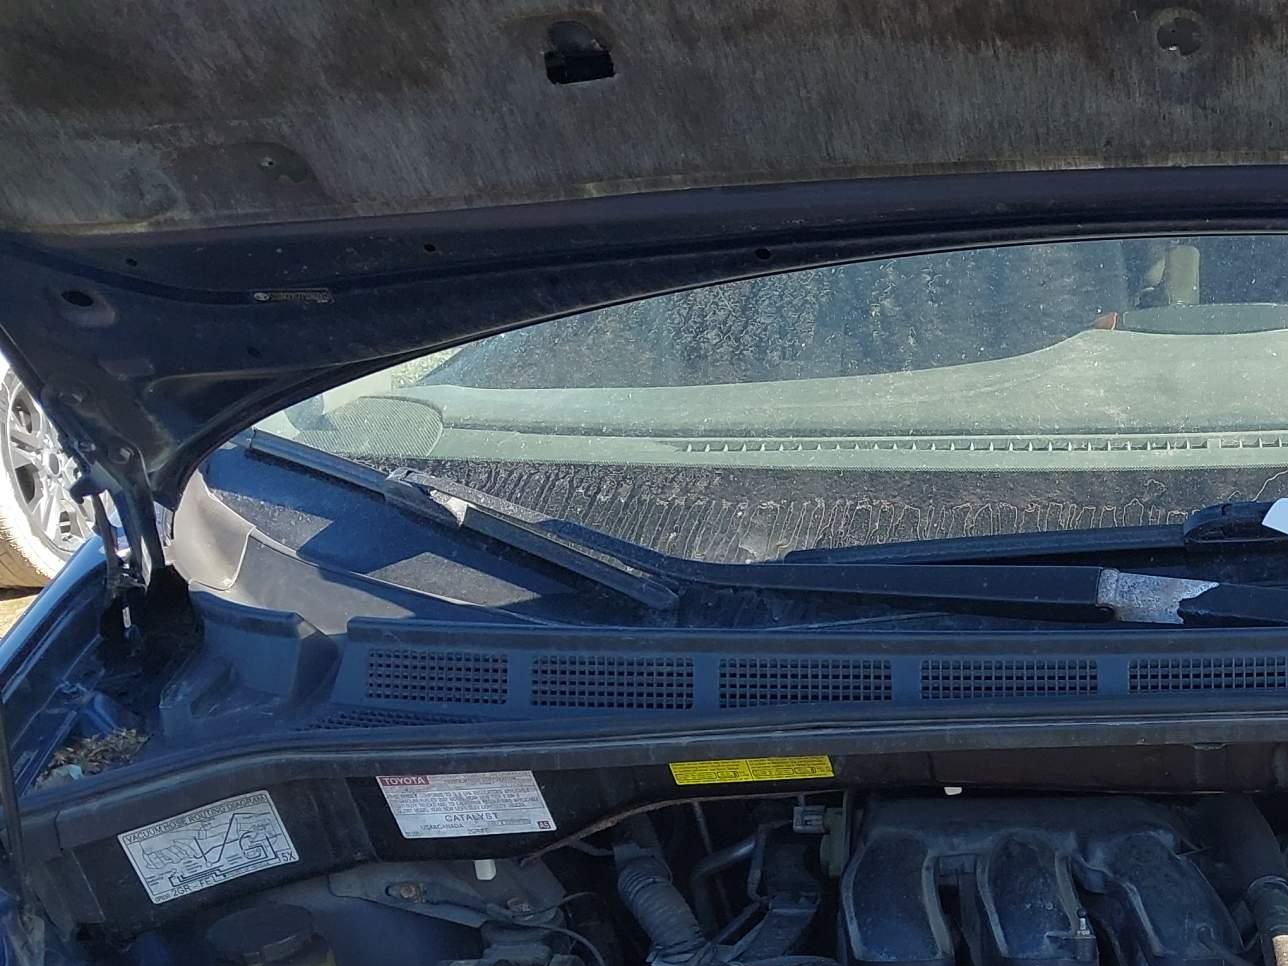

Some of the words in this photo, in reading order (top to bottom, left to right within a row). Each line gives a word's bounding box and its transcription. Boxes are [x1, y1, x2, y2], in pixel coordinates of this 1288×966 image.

[384, 776, 425, 785] TOYOTA
[126, 826, 165, 843] VACUUM
[164, 817, 187, 832] HOSE
[188, 807, 227, 824] ROUTING
[228, 794, 267, 811] DIAGRAM
[445, 812, 498, 822] CATALYST
